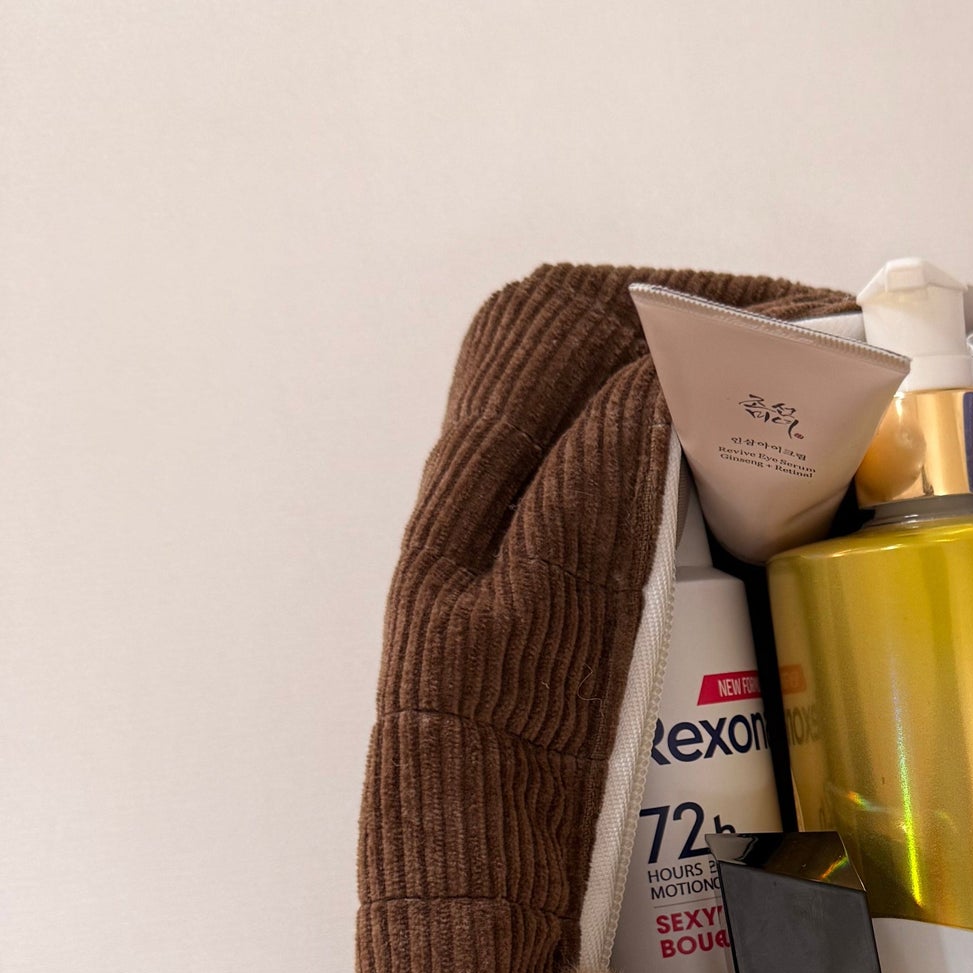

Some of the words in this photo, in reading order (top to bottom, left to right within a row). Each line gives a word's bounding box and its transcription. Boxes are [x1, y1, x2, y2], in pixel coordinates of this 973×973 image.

[718, 446, 756, 457] Revive
[758, 453, 778, 463] Eye
[780, 459, 816, 473] Serum
[720, 453, 764, 468] Ginseng
[718, 678, 742, 697] NEW
[651, 711, 769, 765] Rexon
[639, 801, 712, 865] 72
[647, 862, 704, 883] HOURS
